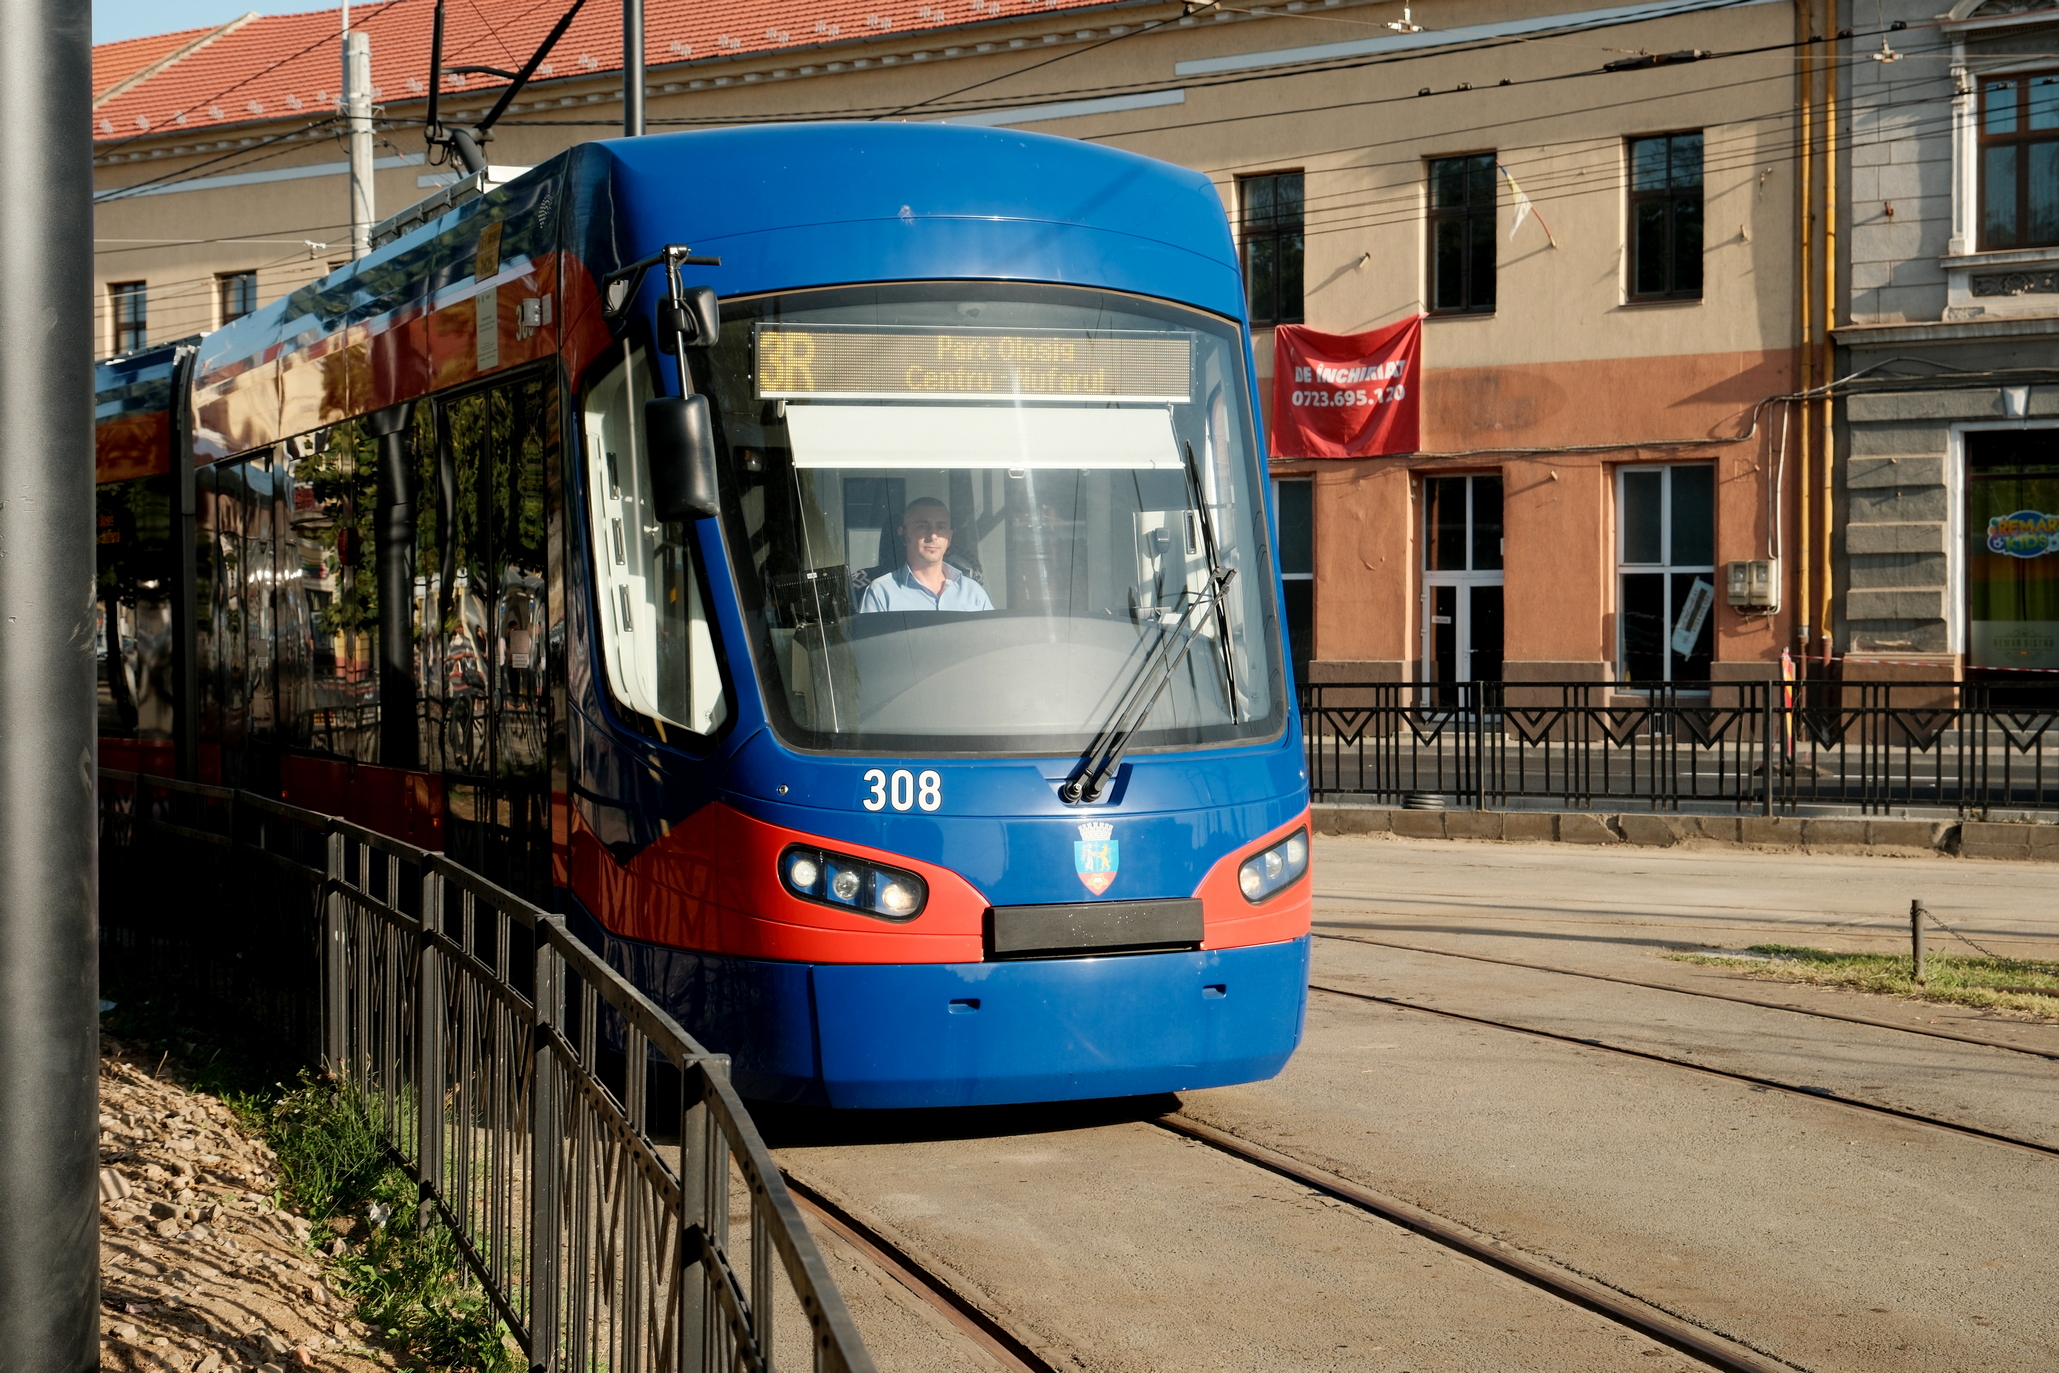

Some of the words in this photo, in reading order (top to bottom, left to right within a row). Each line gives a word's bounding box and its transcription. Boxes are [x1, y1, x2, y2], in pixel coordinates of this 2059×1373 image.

[937, 335, 991, 360] Parc
[760, 331, 814, 391] 3R
[906, 365, 992, 390] Centru
[1294, 366, 1312, 383] DE
[1292, 384, 1405, 407] 0723.695.120
[1998, 518, 2059, 535] REMAR
[2005, 534, 2048, 551] KIDS
[862, 768, 943, 812] 308
